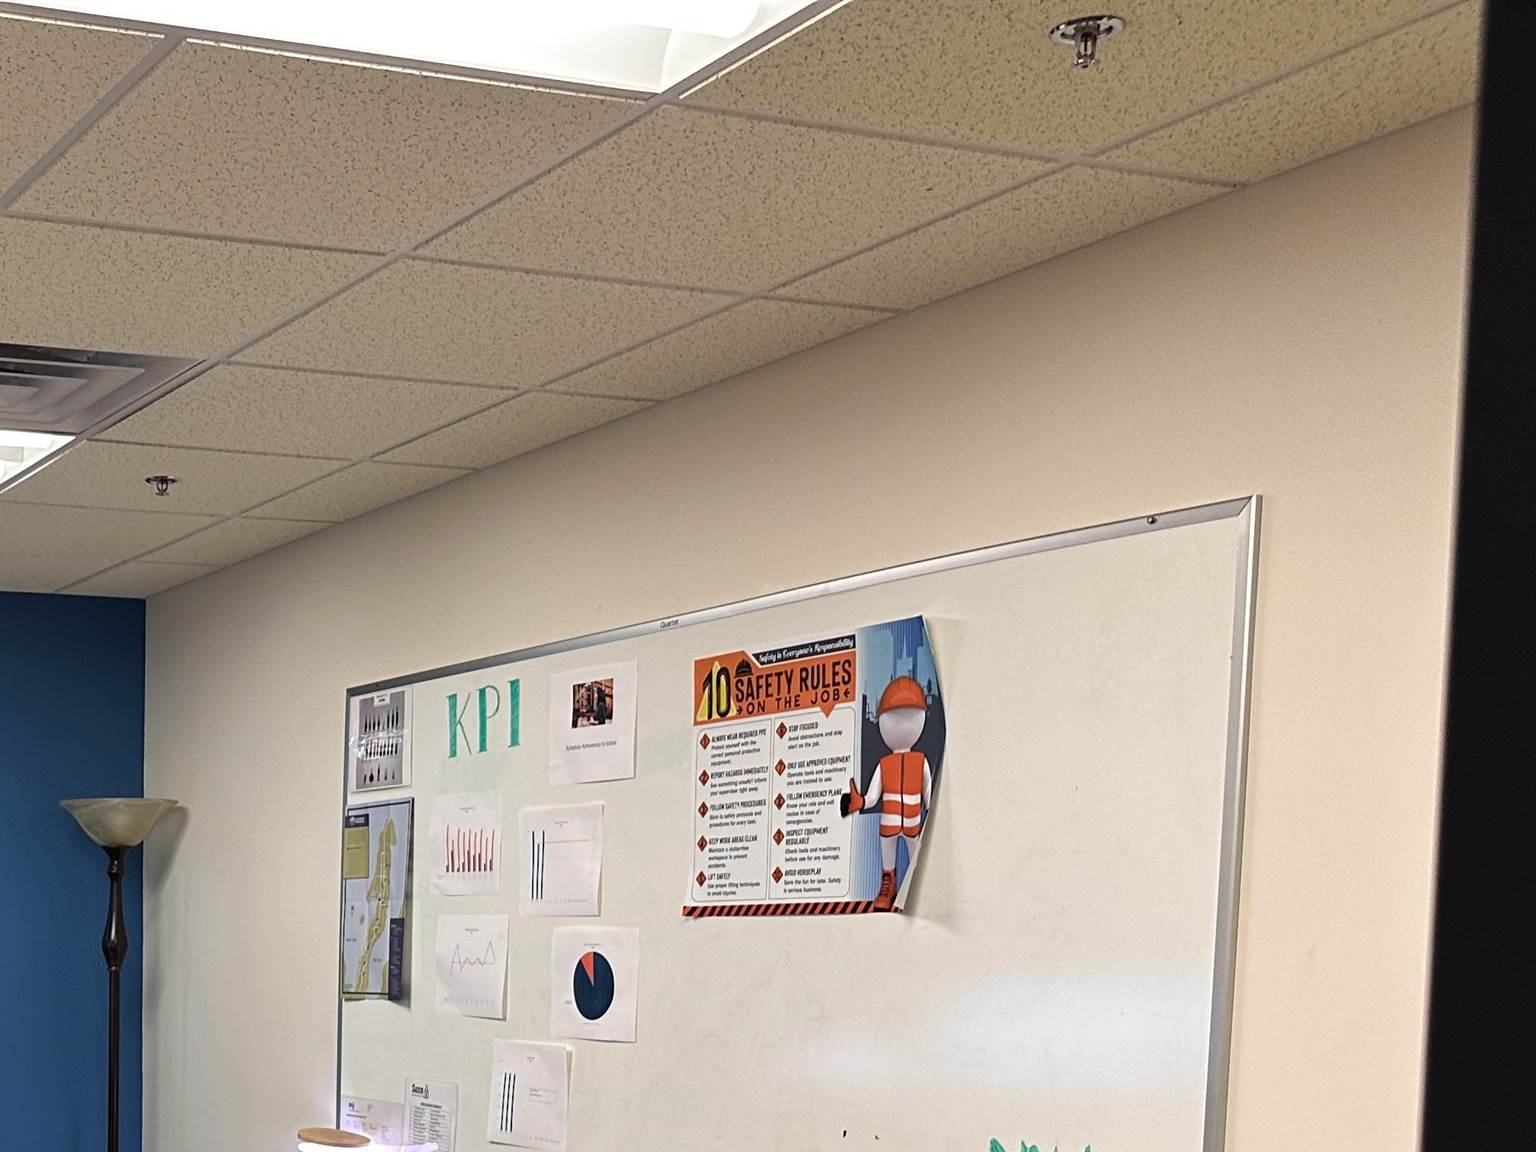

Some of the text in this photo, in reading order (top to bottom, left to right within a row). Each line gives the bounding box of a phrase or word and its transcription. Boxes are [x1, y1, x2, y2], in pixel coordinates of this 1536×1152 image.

[703, 666, 731, 720] 10
[735, 659, 851, 702] SAFETY RULES
[746, 688, 840, 715] ON THE JOB
[446, 678, 520, 758] KPI
